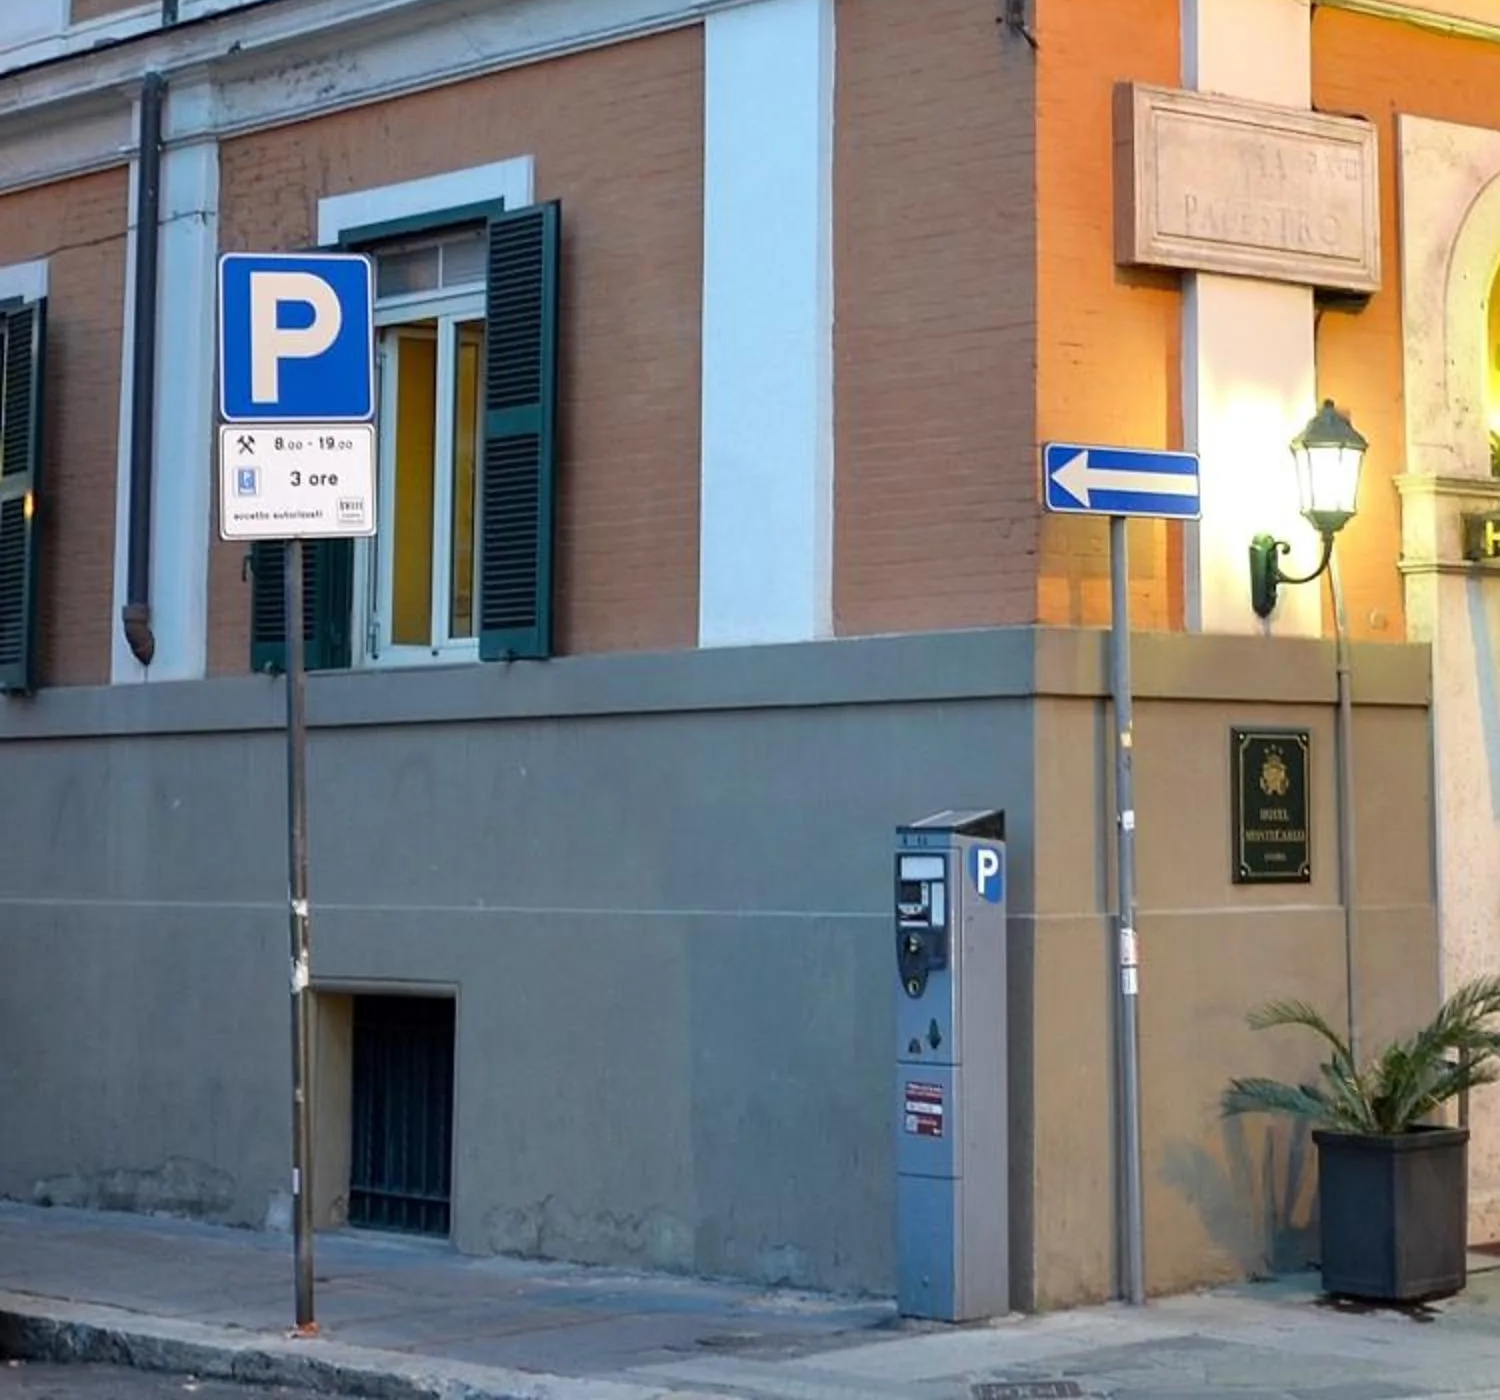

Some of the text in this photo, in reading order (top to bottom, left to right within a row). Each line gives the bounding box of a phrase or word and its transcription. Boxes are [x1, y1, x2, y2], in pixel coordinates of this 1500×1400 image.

[250, 271, 343, 404] P
[290, 470, 339, 487] 3 ore
[977, 849, 999, 895] P
